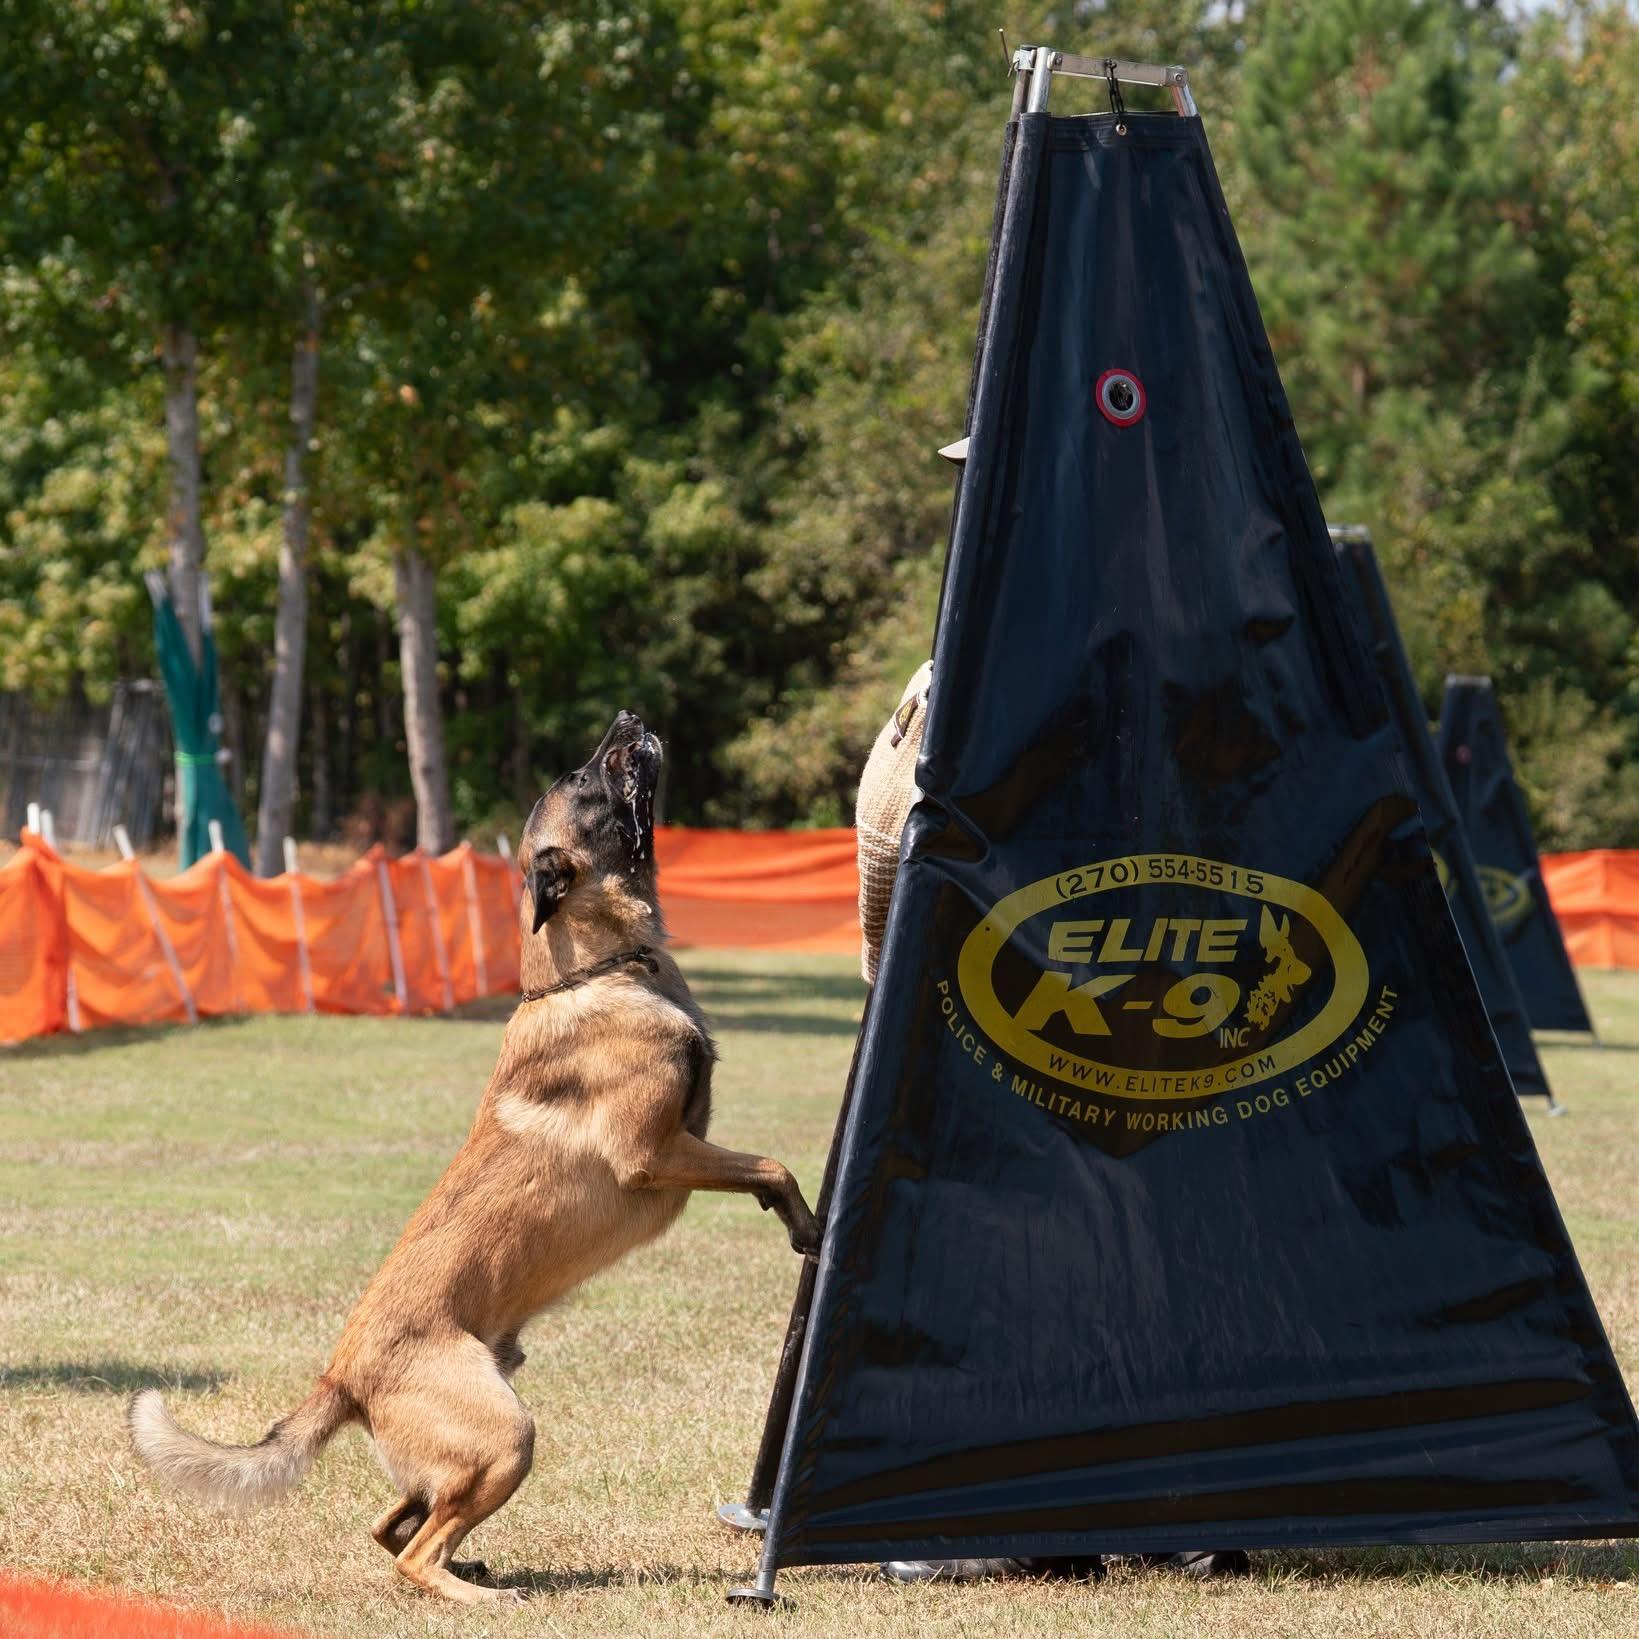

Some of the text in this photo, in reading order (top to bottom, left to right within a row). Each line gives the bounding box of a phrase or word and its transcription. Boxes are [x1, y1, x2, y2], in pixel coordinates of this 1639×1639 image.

[1056, 858, 1264, 898] (270) 554-5515
[1048, 919, 1249, 963] ELITE
[1016, 971, 1240, 1038] K-9
[937, 980, 1398, 1131] POLICE & MILITARY WORKING DOG EQUIPMENT
[1220, 1027, 1249, 1048] INC
[1048, 1054, 1276, 1092] WWW.ELITEK9.COM
